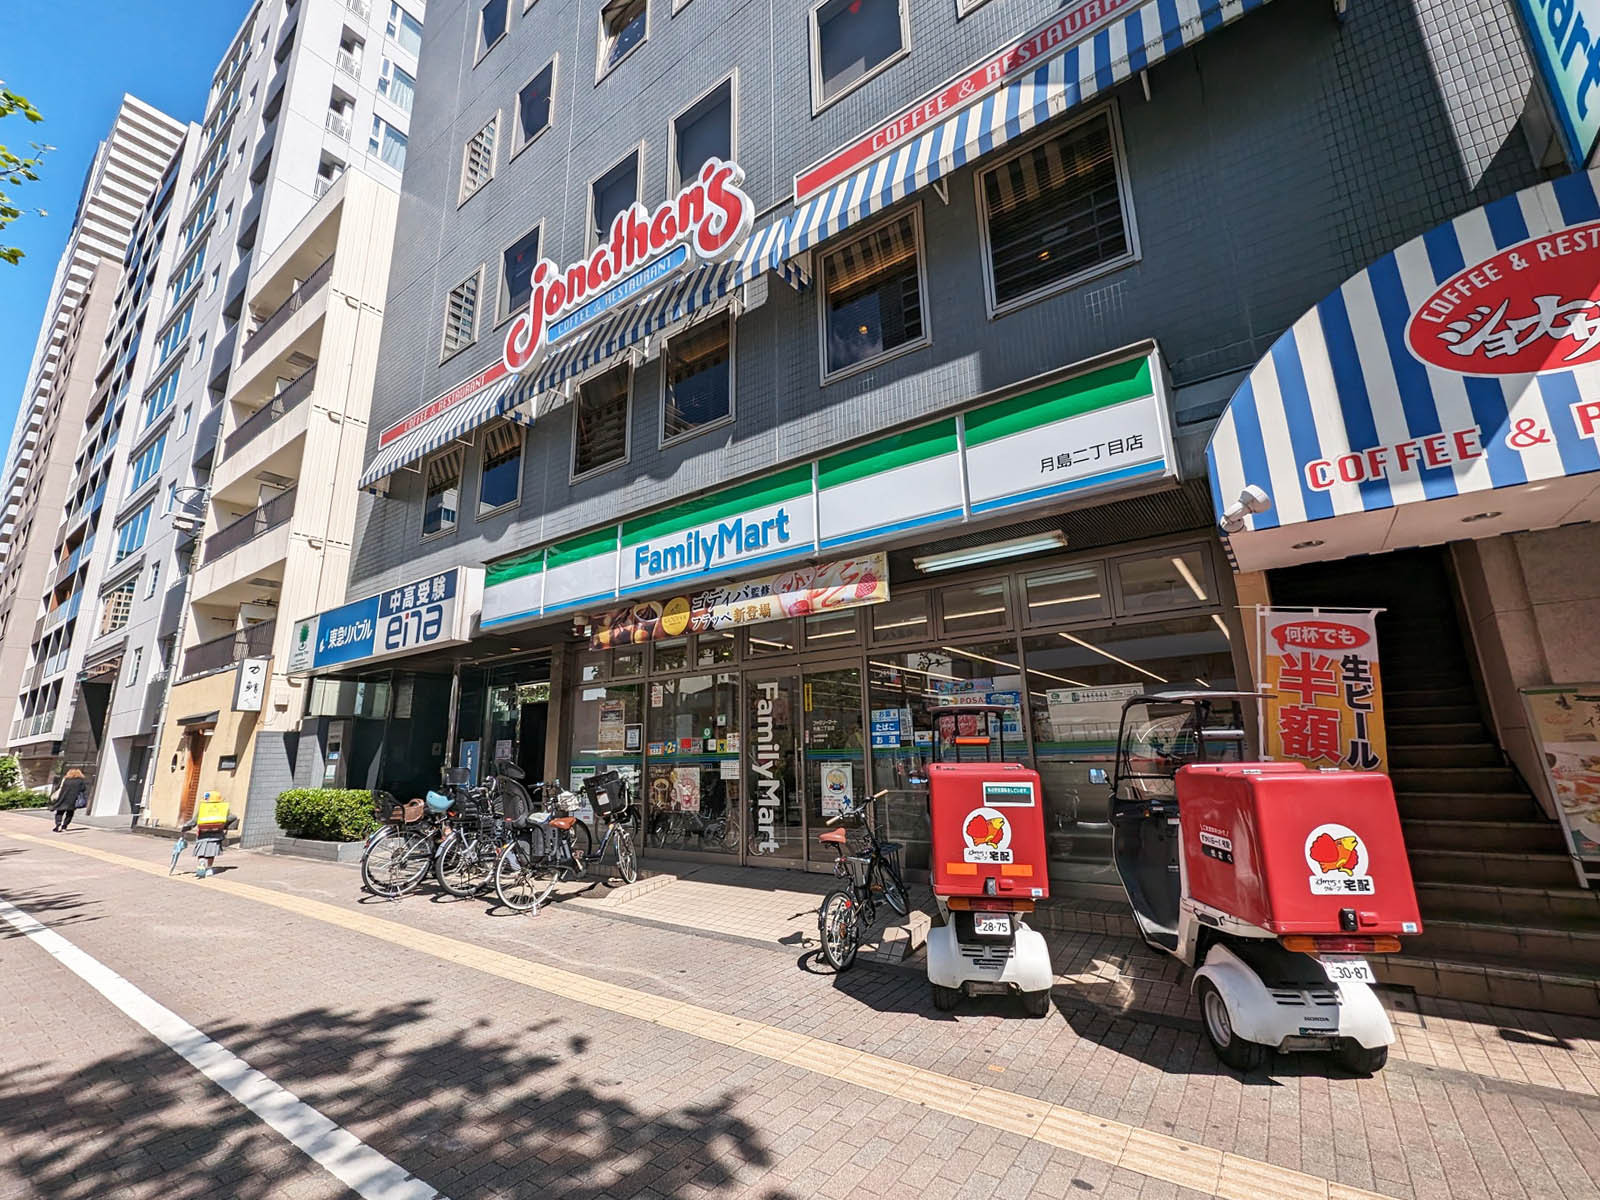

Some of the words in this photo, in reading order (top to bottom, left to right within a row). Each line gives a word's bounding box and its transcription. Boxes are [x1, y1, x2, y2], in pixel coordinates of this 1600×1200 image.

[871, 92, 951, 151] COFFEE
[958, 79, 977, 99] &
[605, 256, 672, 305] RESTAURANT
[1421, 262, 1503, 323] COFFEE
[1508, 252, 1530, 271] &
[1040, 434, 1144, 473] 月島二丁目店
[1307, 428, 1483, 489] COFFEE
[1510, 418, 1551, 448] &
[634, 507, 790, 579] FamilyMart
[388, 574, 447, 613] 中高受験
[327, 618, 373, 649] 東急リバブル
[1284, 626, 1357, 645] 何杯でも
[1278, 651, 1344, 764] 半額
[1340, 654, 1380, 769] 生ビール
[751, 682, 780, 853] FamilyMart
[1343, 879, 1371, 892] 宅配
